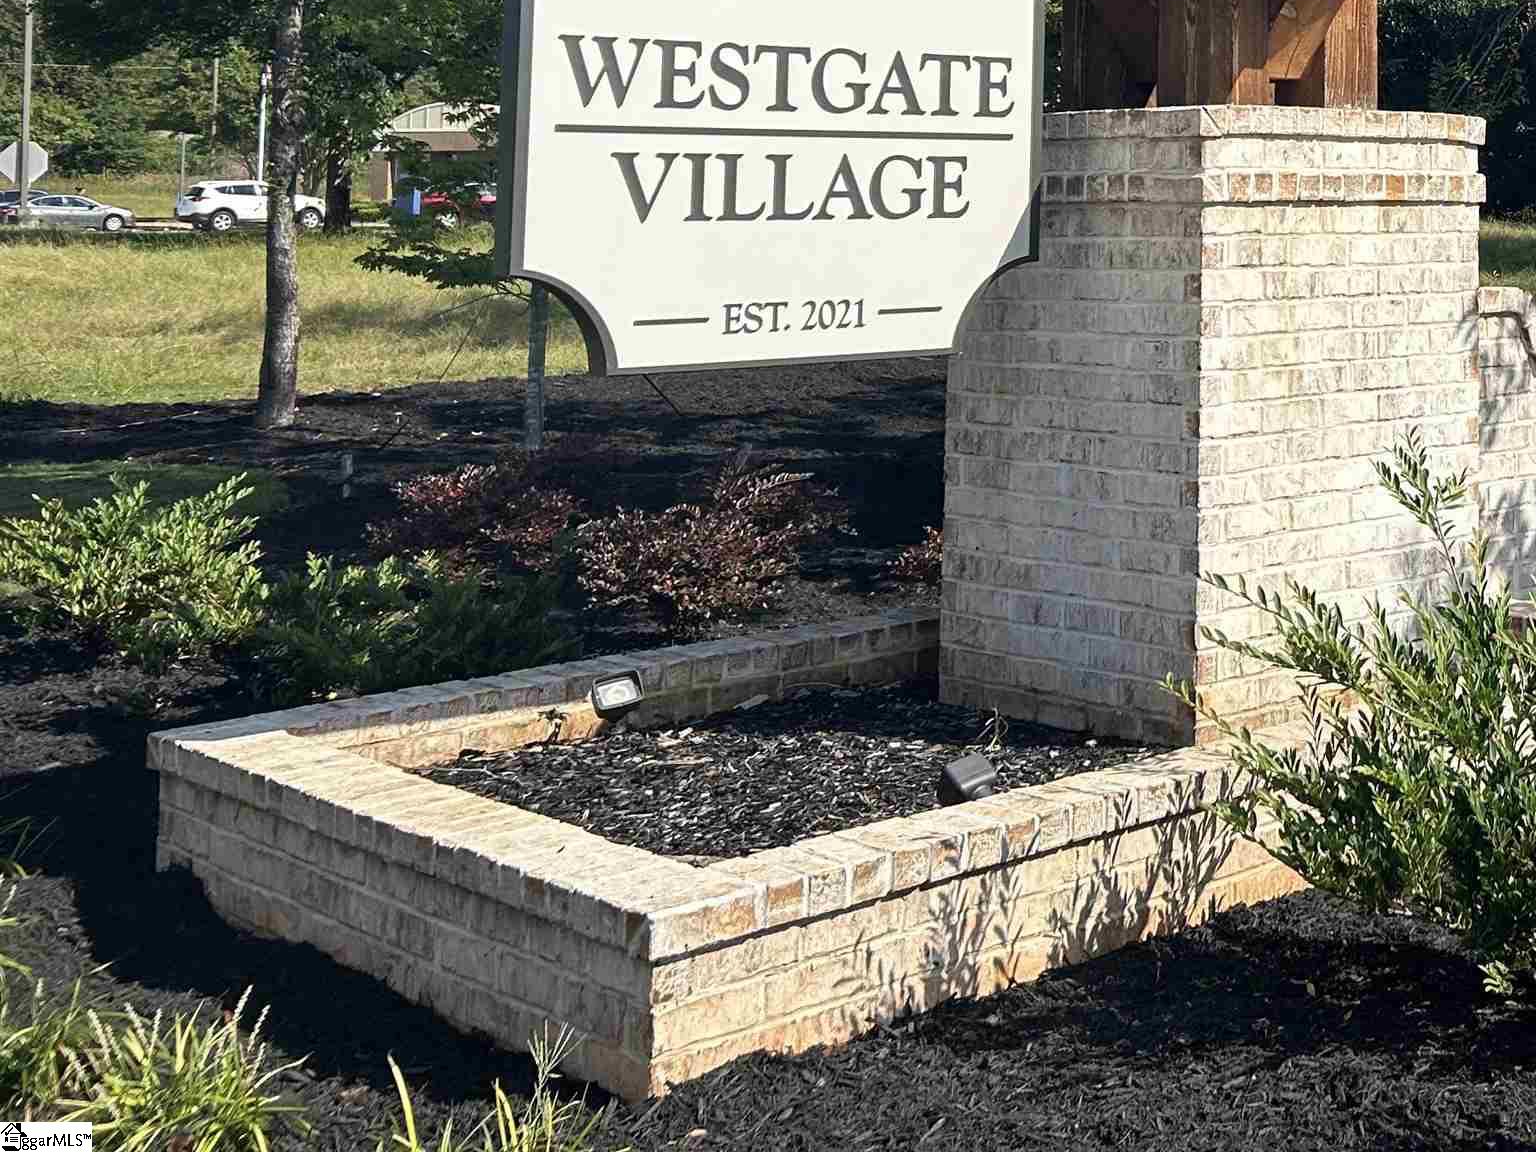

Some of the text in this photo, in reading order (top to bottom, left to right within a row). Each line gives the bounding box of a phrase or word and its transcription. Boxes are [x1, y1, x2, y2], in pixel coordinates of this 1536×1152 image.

[557, 34, 1015, 119] WESTGATE
[610, 151, 970, 224] VILLAGE
[721, 298, 865, 336] EST. 2021
